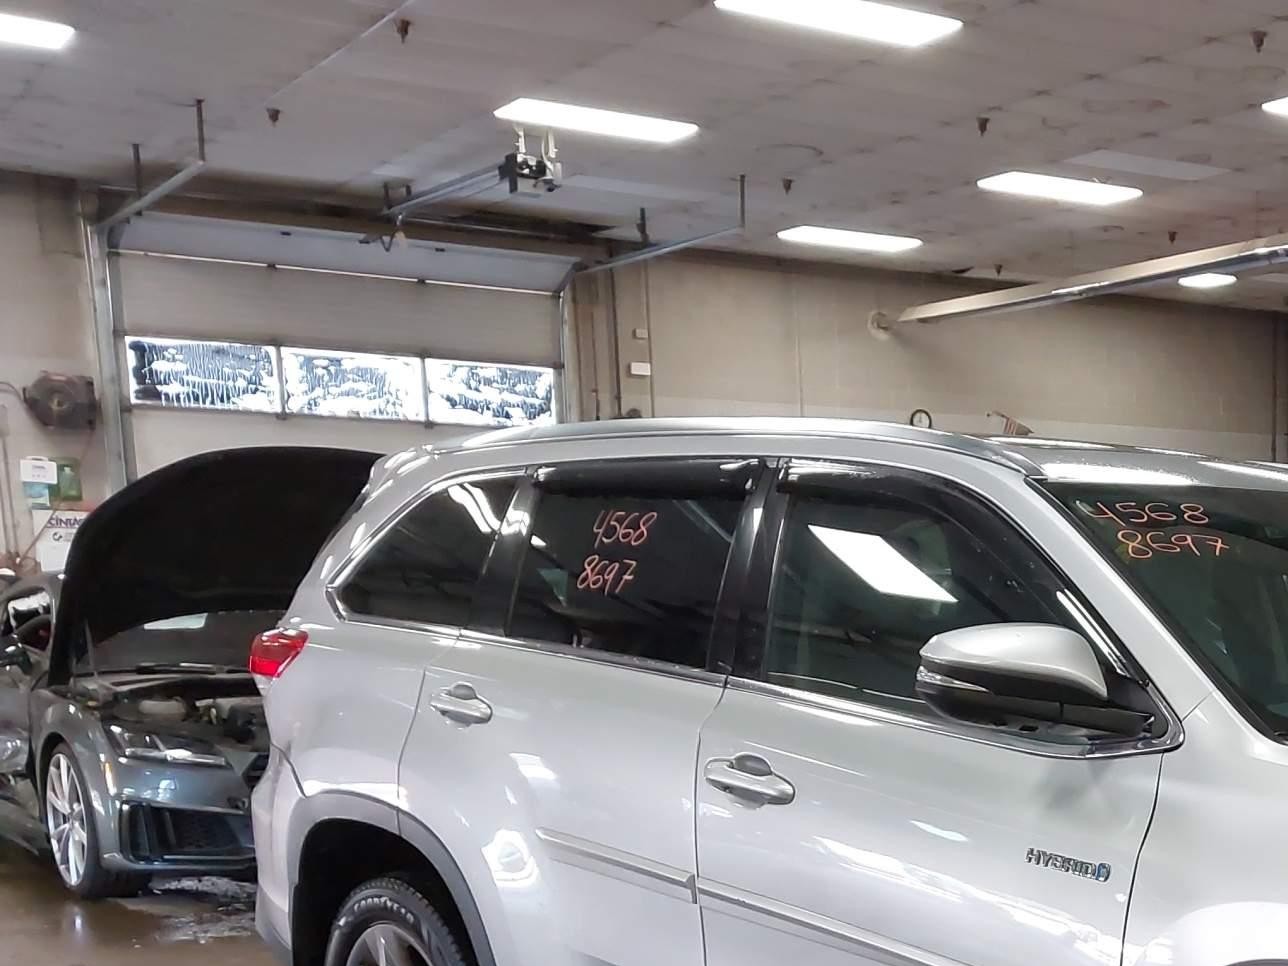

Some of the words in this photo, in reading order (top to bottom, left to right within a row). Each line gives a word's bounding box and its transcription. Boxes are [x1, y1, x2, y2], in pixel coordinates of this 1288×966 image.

[593, 510, 657, 549] 4568
[1079, 502, 1209, 526] 4568
[1117, 529, 1230, 558] 8697
[577, 555, 637, 596] 8697
[1025, 847, 1097, 878] HYBRID
